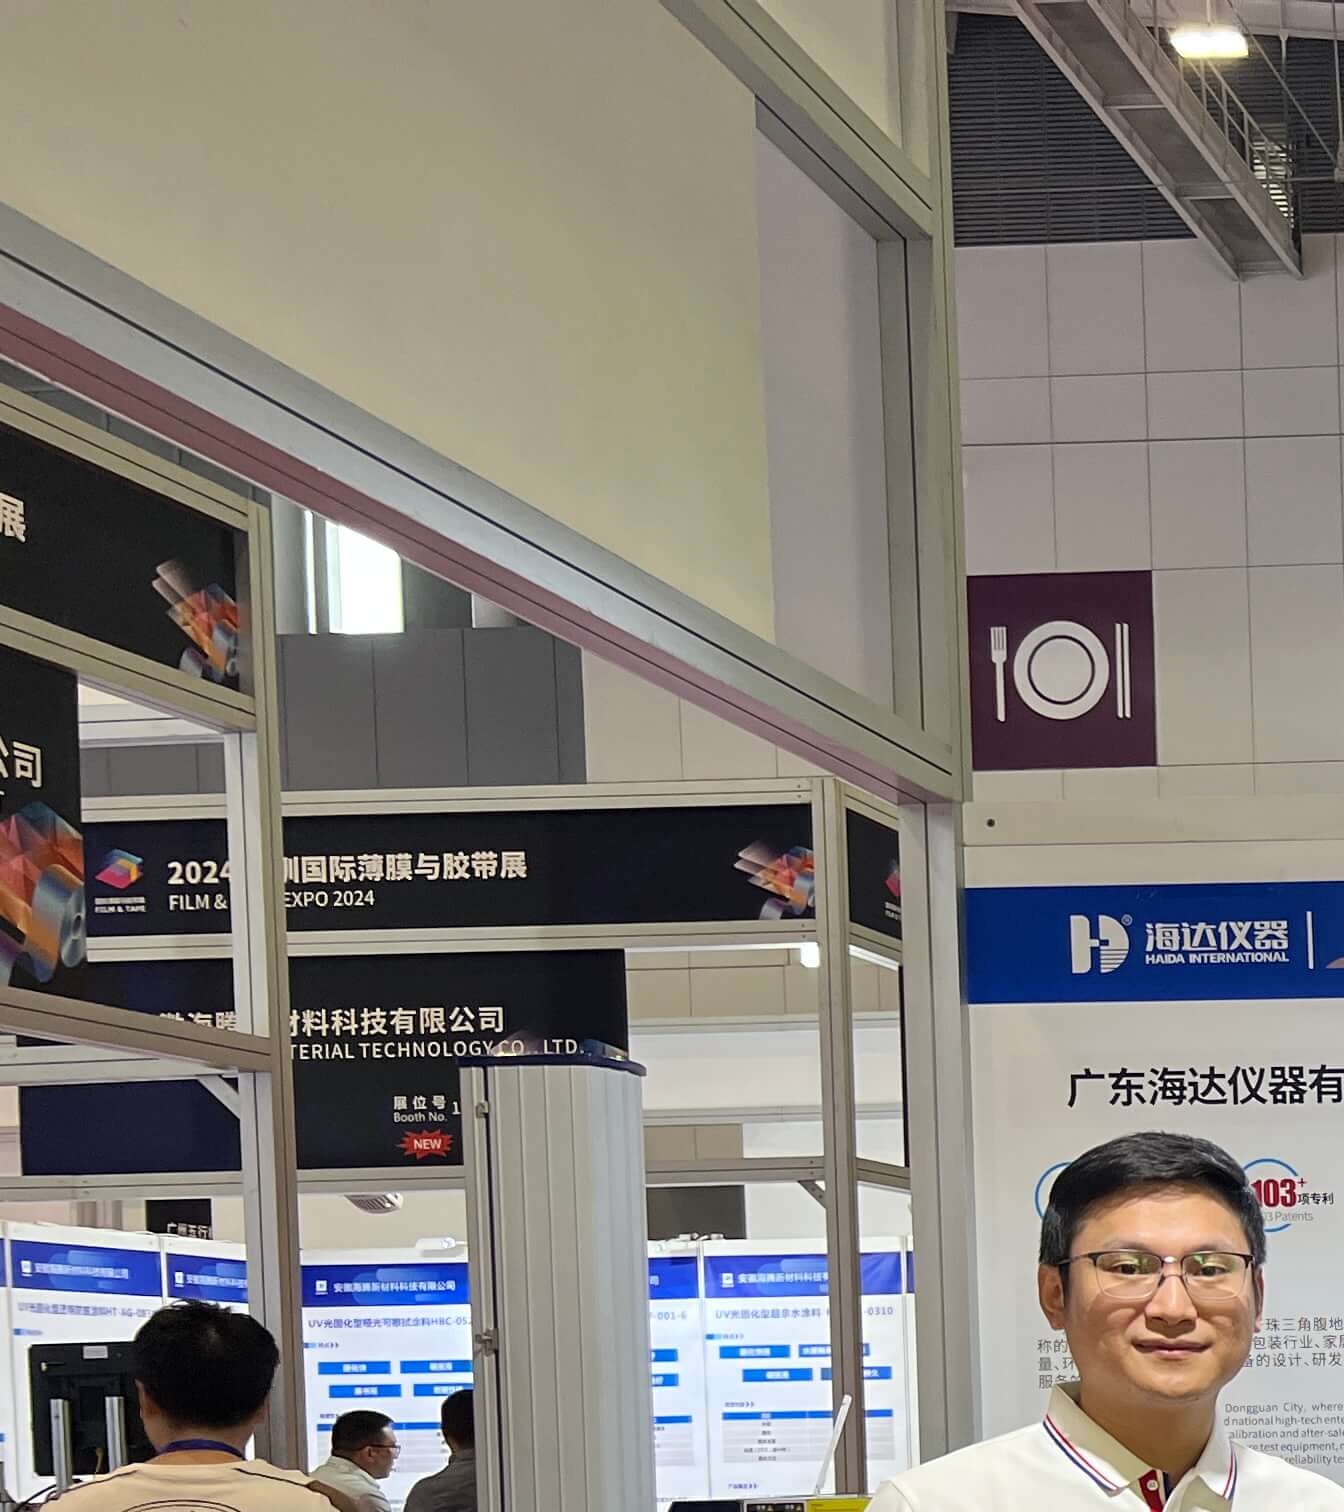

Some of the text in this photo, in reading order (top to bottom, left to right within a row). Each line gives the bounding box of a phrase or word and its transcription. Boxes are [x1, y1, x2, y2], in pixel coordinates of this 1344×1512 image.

[168, 892, 208, 911] FILM
[333, 889, 375, 908] 2024
[1145, 951, 1290, 965] HAIDA INTERNATIONAL
[361, 1040, 495, 1059] TECHNOLOGY
[393, 1112, 448, 1124] Booth No.
[413, 1136, 442, 1151] NEW
[1298, 1192, 1335, 1206] 项专利
[1224, 1403, 1279, 1416] Dongguan
[1311, 1402, 1343, 1412] where
[1231, 1416, 1273, 1427] national
[1279, 1429, 1300, 1439] and
